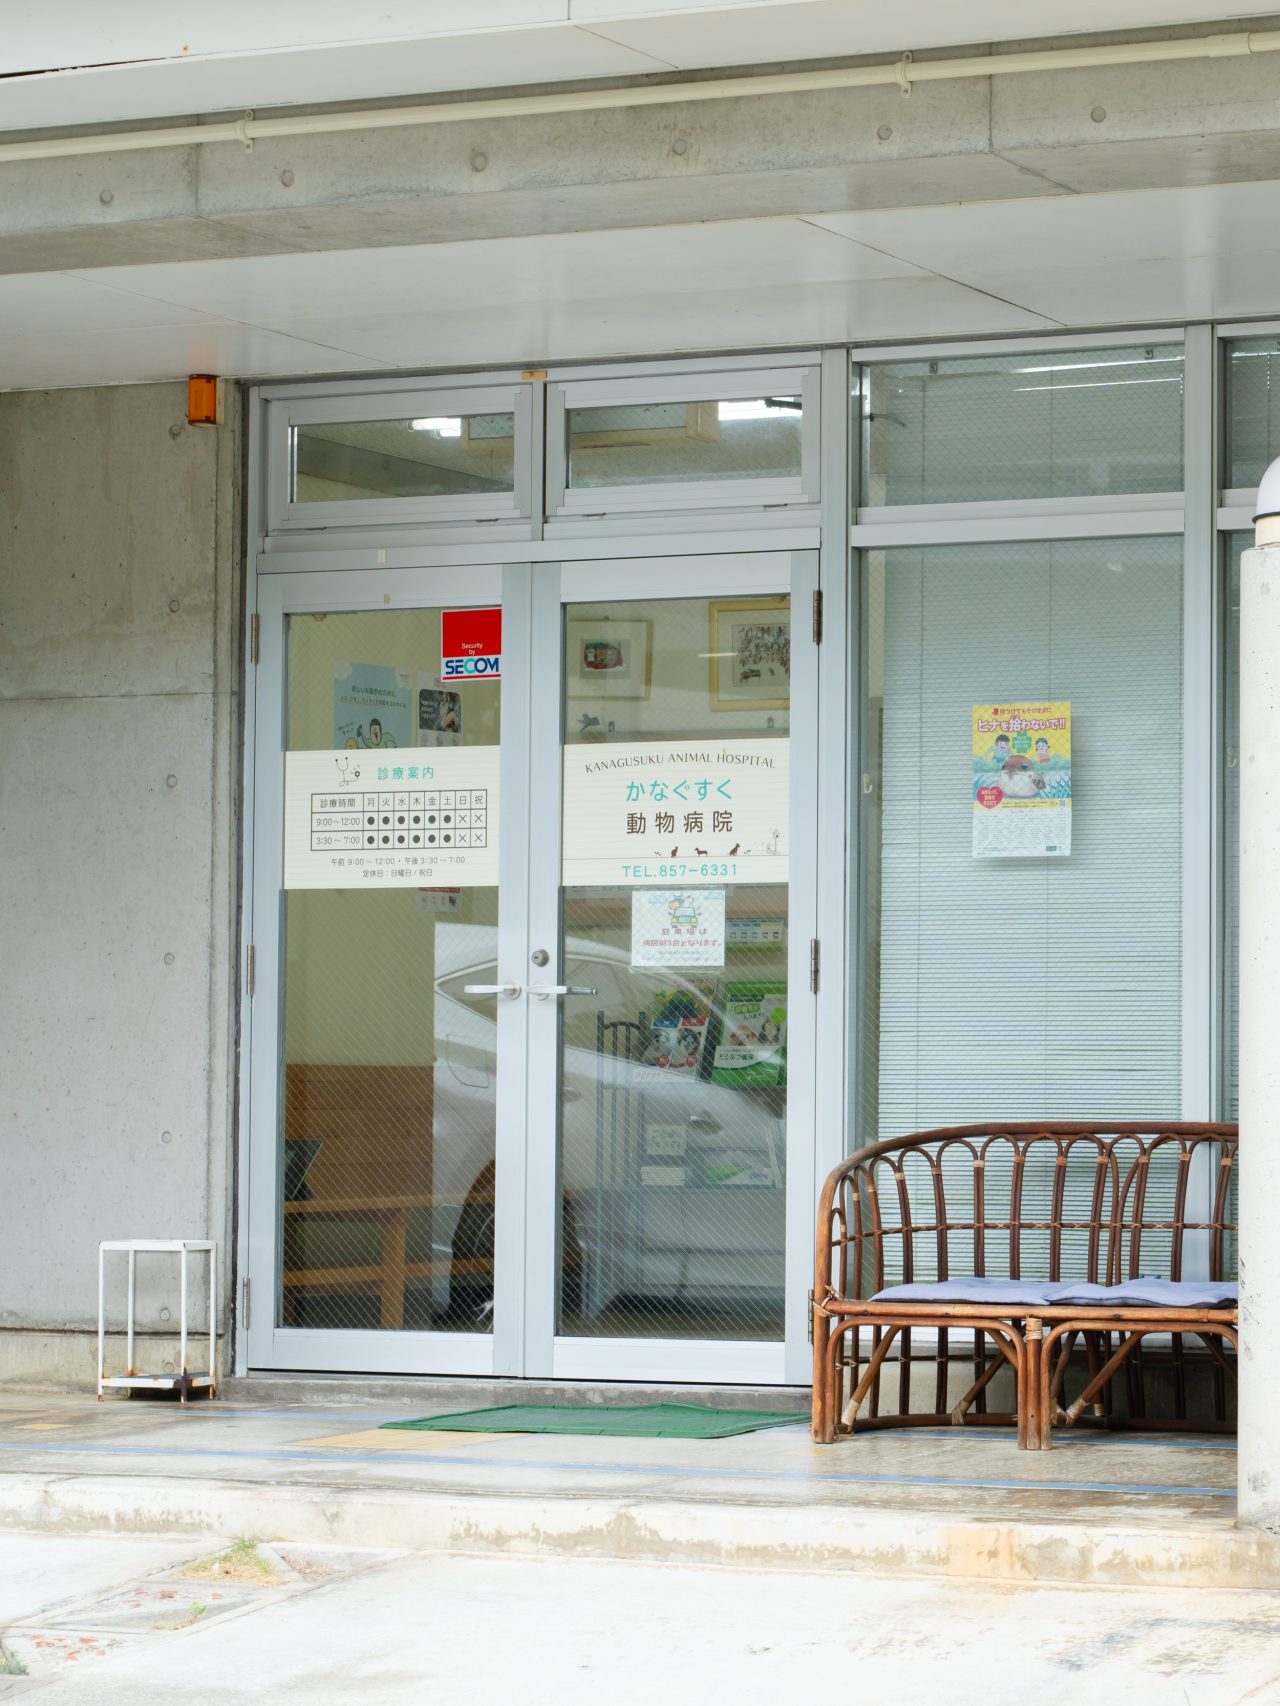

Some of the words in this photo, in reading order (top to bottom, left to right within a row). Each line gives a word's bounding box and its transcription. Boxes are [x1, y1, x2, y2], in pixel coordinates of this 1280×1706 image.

[445, 657, 499, 675] SECOM
[585, 754, 664, 774] KANAGUSUKU
[668, 752, 712, 763] ANIMAL
[716, 752, 776, 769] HOSPITAL
[377, 766, 434, 781] 診療案内
[626, 778, 732, 802] かなぐすく
[319, 798, 356, 808] 診療時間
[367, 797, 375, 807] 月
[382, 797, 390, 807] 火
[397, 796, 406, 806] 水
[412, 796, 421, 806] 木
[427, 796, 436, 805] 金
[443, 796, 452, 805] 土
[459, 796, 467, 805] 日
[475, 795, 483, 805] 祝
[626, 810, 733, 834] 動物病院
[622, 864, 737, 878] TEL.857-6331
